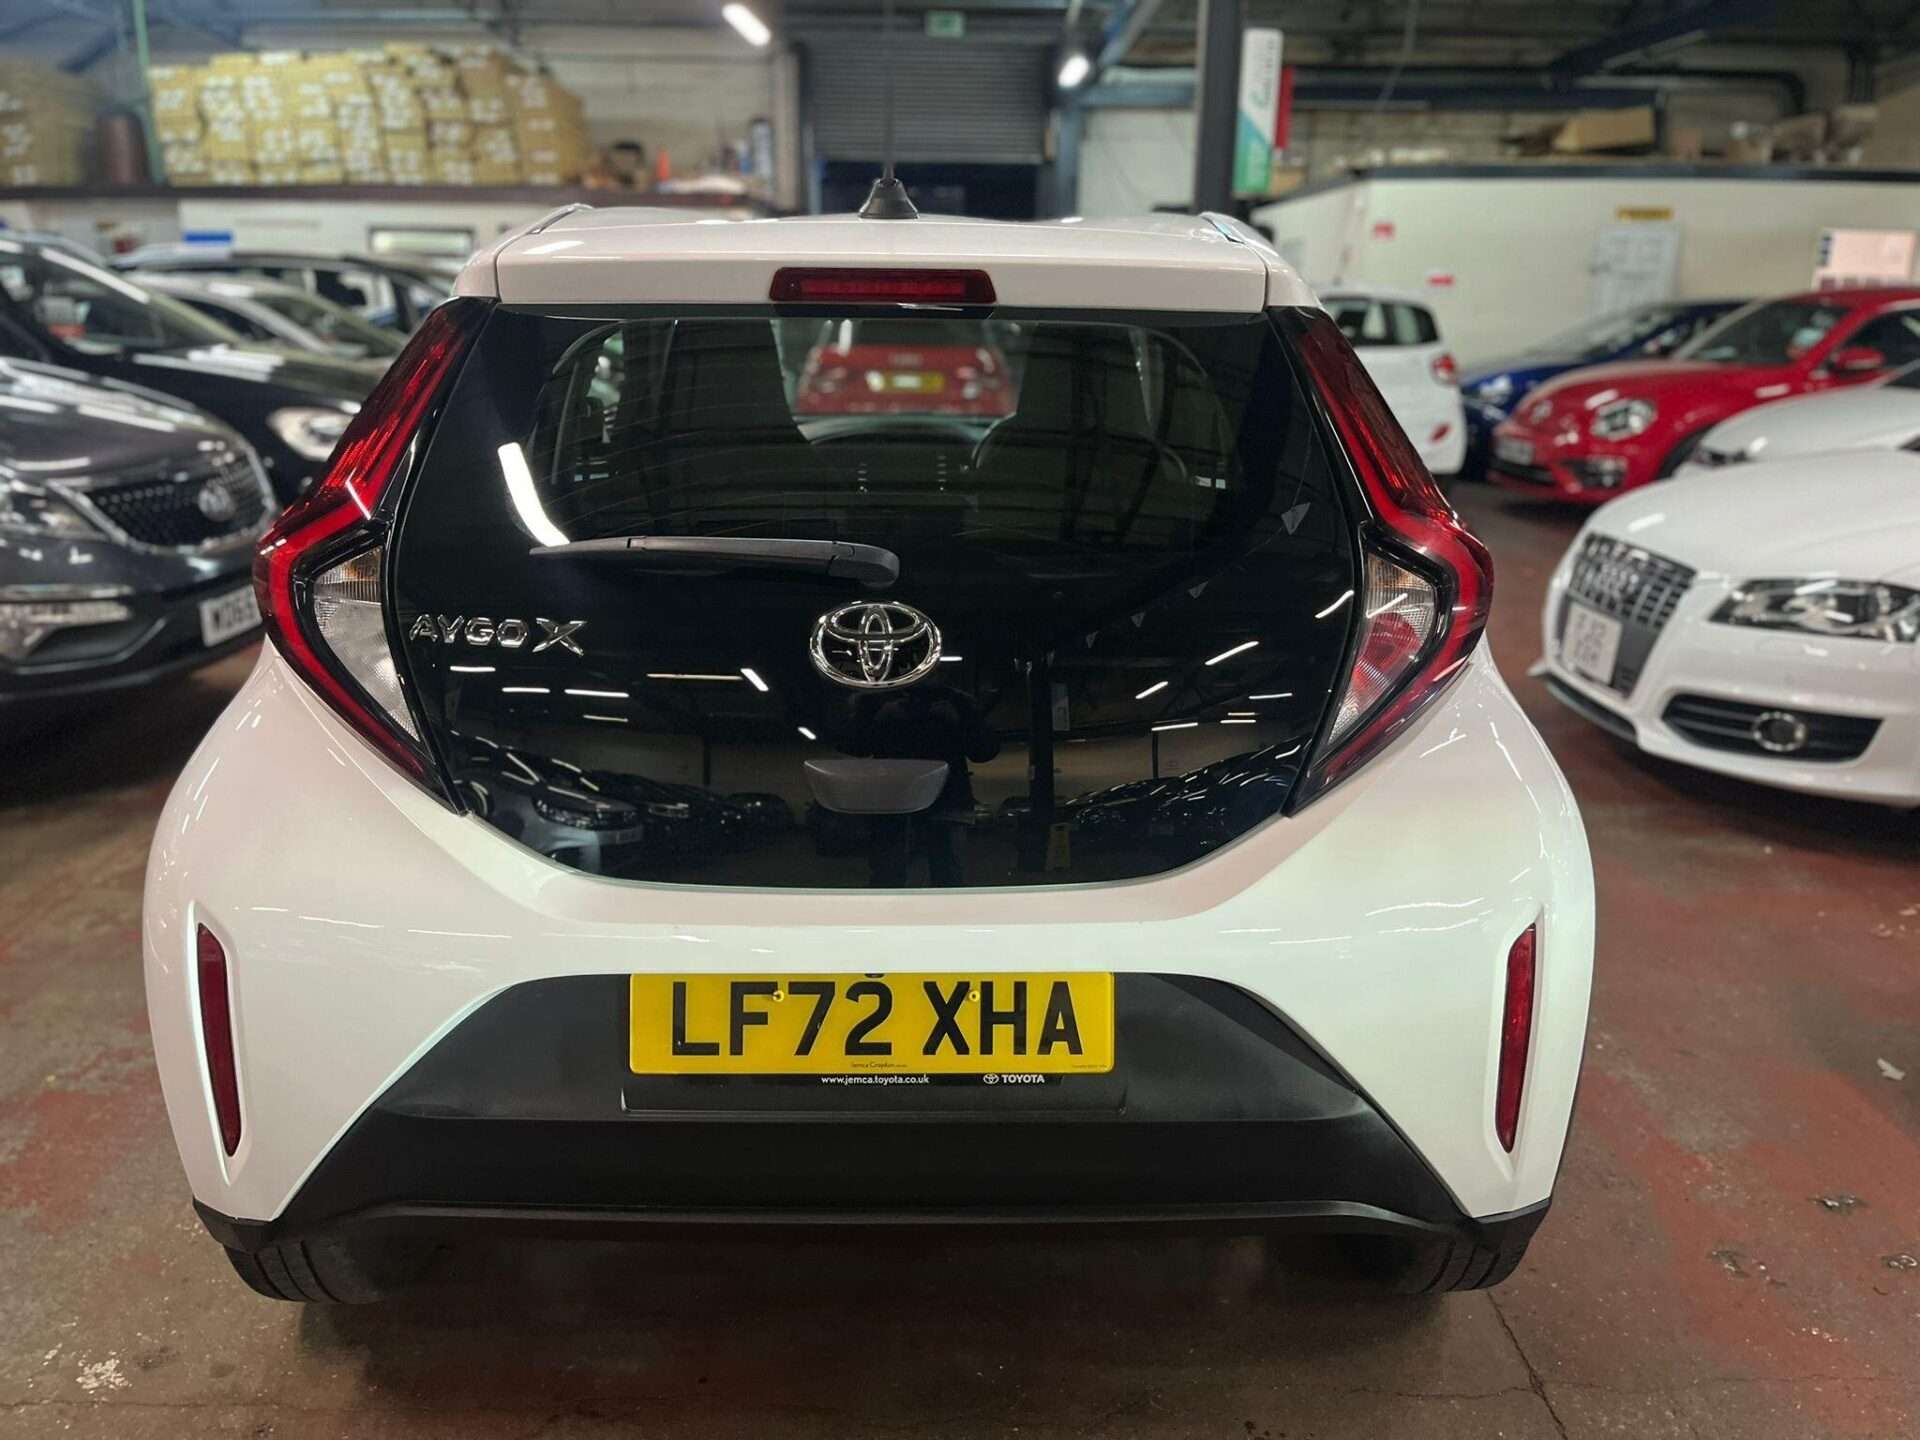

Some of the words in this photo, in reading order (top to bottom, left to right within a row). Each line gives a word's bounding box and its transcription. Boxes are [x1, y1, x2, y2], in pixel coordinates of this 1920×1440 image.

[409, 614, 530, 648] AYGO
[532, 617, 587, 656] X
[672, 981, 893, 1056] LF72
[922, 981, 1084, 1056] XHA
[821, 1074, 930, 1086] www.jemca.toyota.co.uk
[1001, 1074, 1045, 1084] TOYOTA
